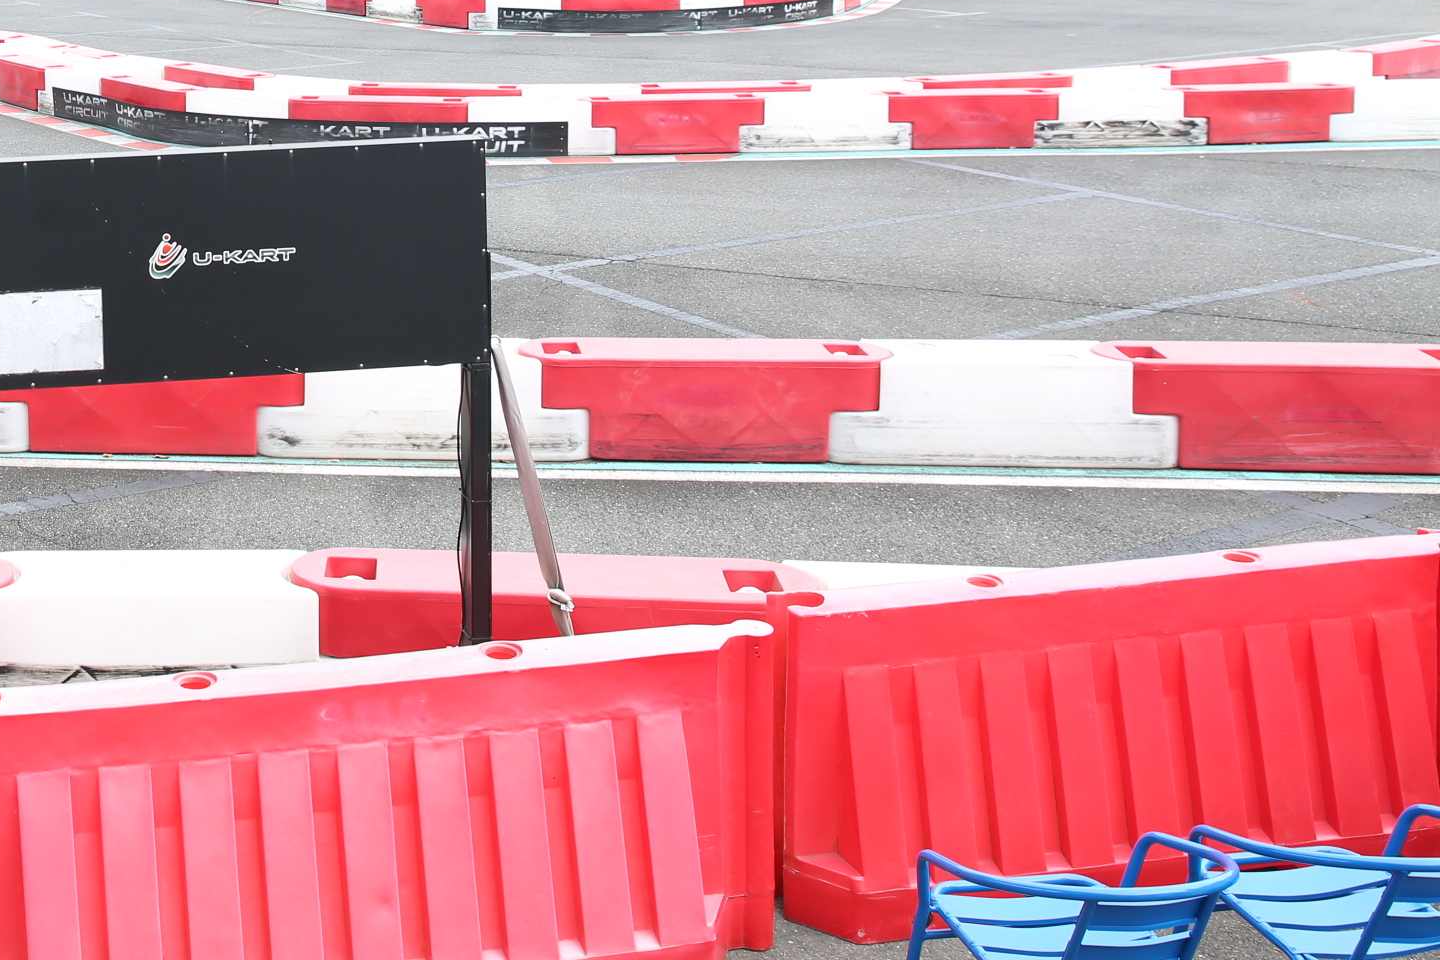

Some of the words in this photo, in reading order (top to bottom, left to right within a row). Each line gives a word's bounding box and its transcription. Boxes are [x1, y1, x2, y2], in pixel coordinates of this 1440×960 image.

[784, 0, 818, 12] U-KART
[63, 92, 108, 107] U-KART
[65, 105, 109, 120] CIRCUIT
[192, 247, 296, 266] U-KART
